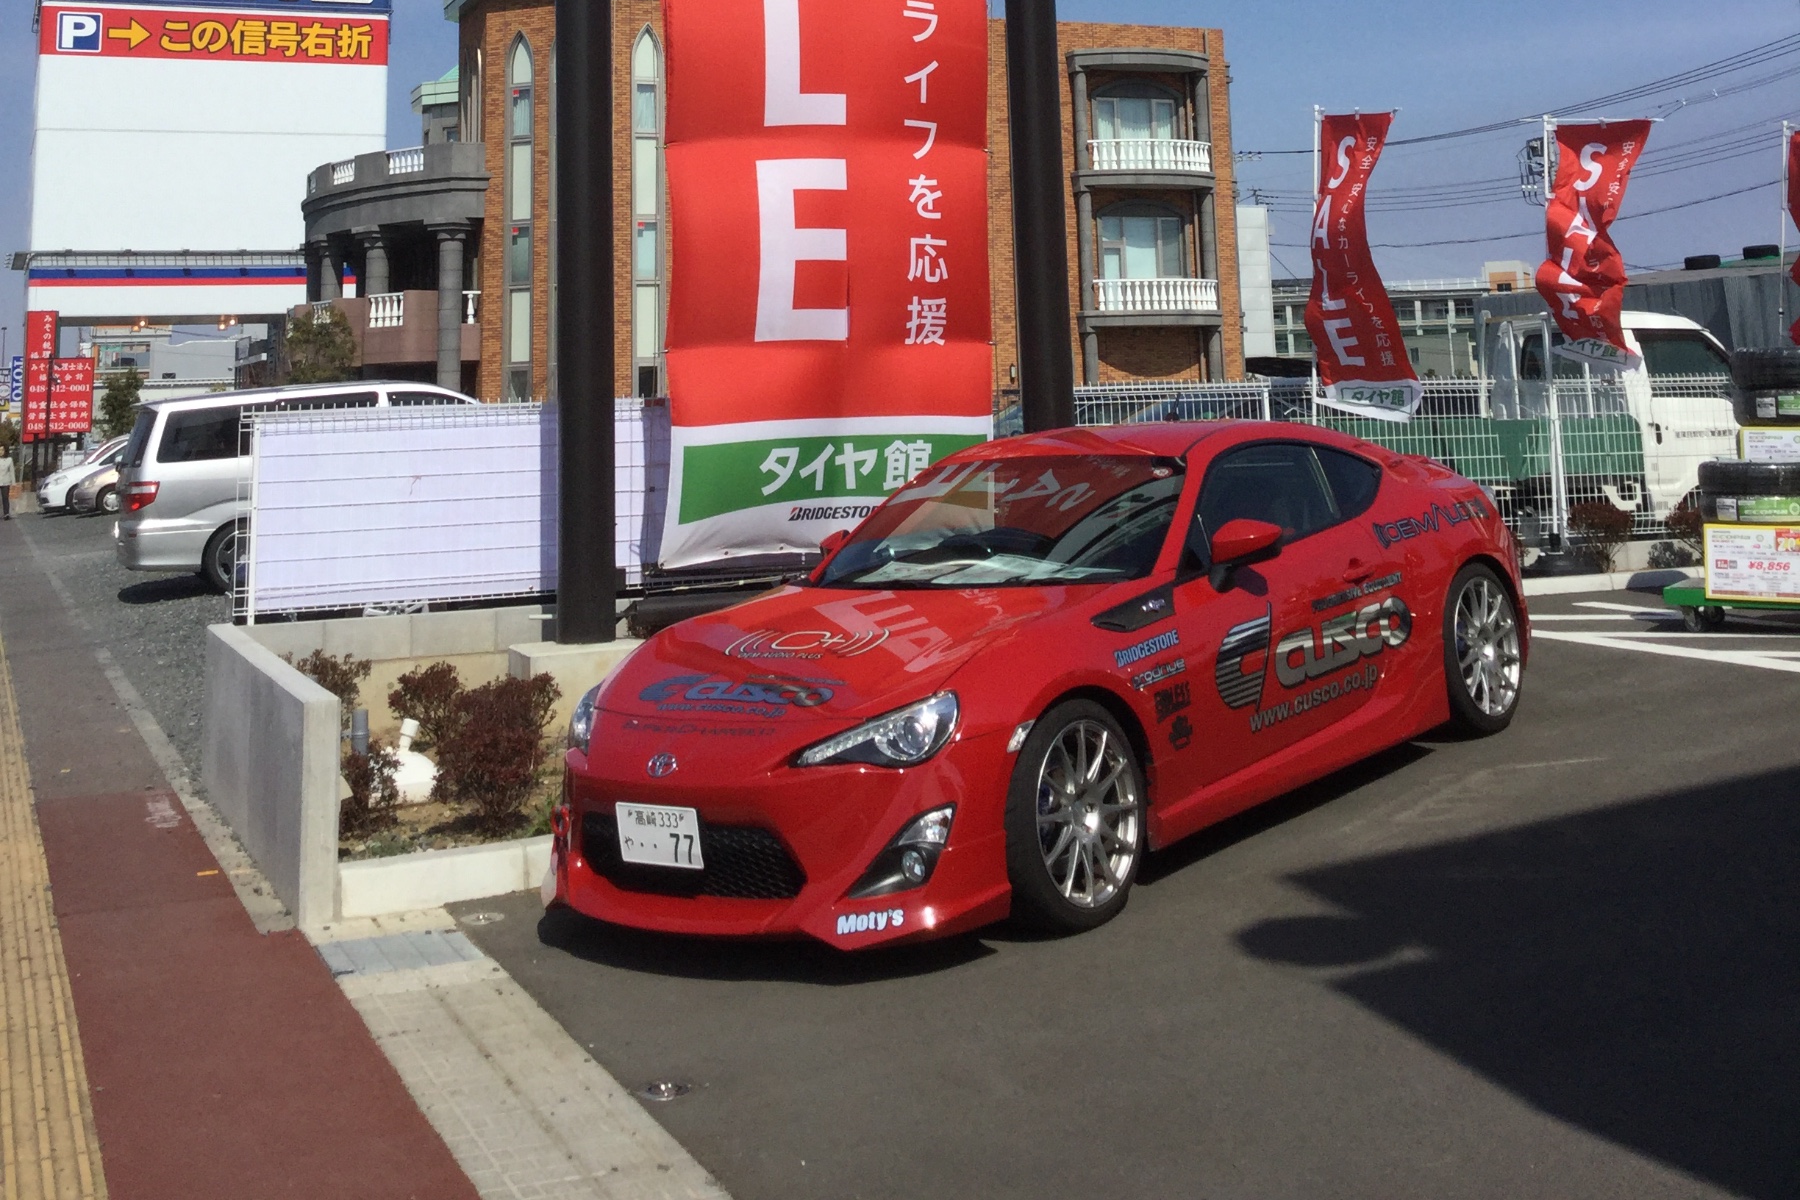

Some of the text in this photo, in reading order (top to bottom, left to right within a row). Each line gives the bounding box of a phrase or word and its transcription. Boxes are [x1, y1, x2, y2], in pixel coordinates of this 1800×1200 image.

[60, 14, 98, 50] P
[159, 17, 374, 60] この信号右折
[759, 440, 932, 495] タイヤ館
[787, 505, 880, 522] BRIDGESTO
[1114, 629, 1179, 668] BRIDGESTONE
[836, 909, 904, 935] Moty's
